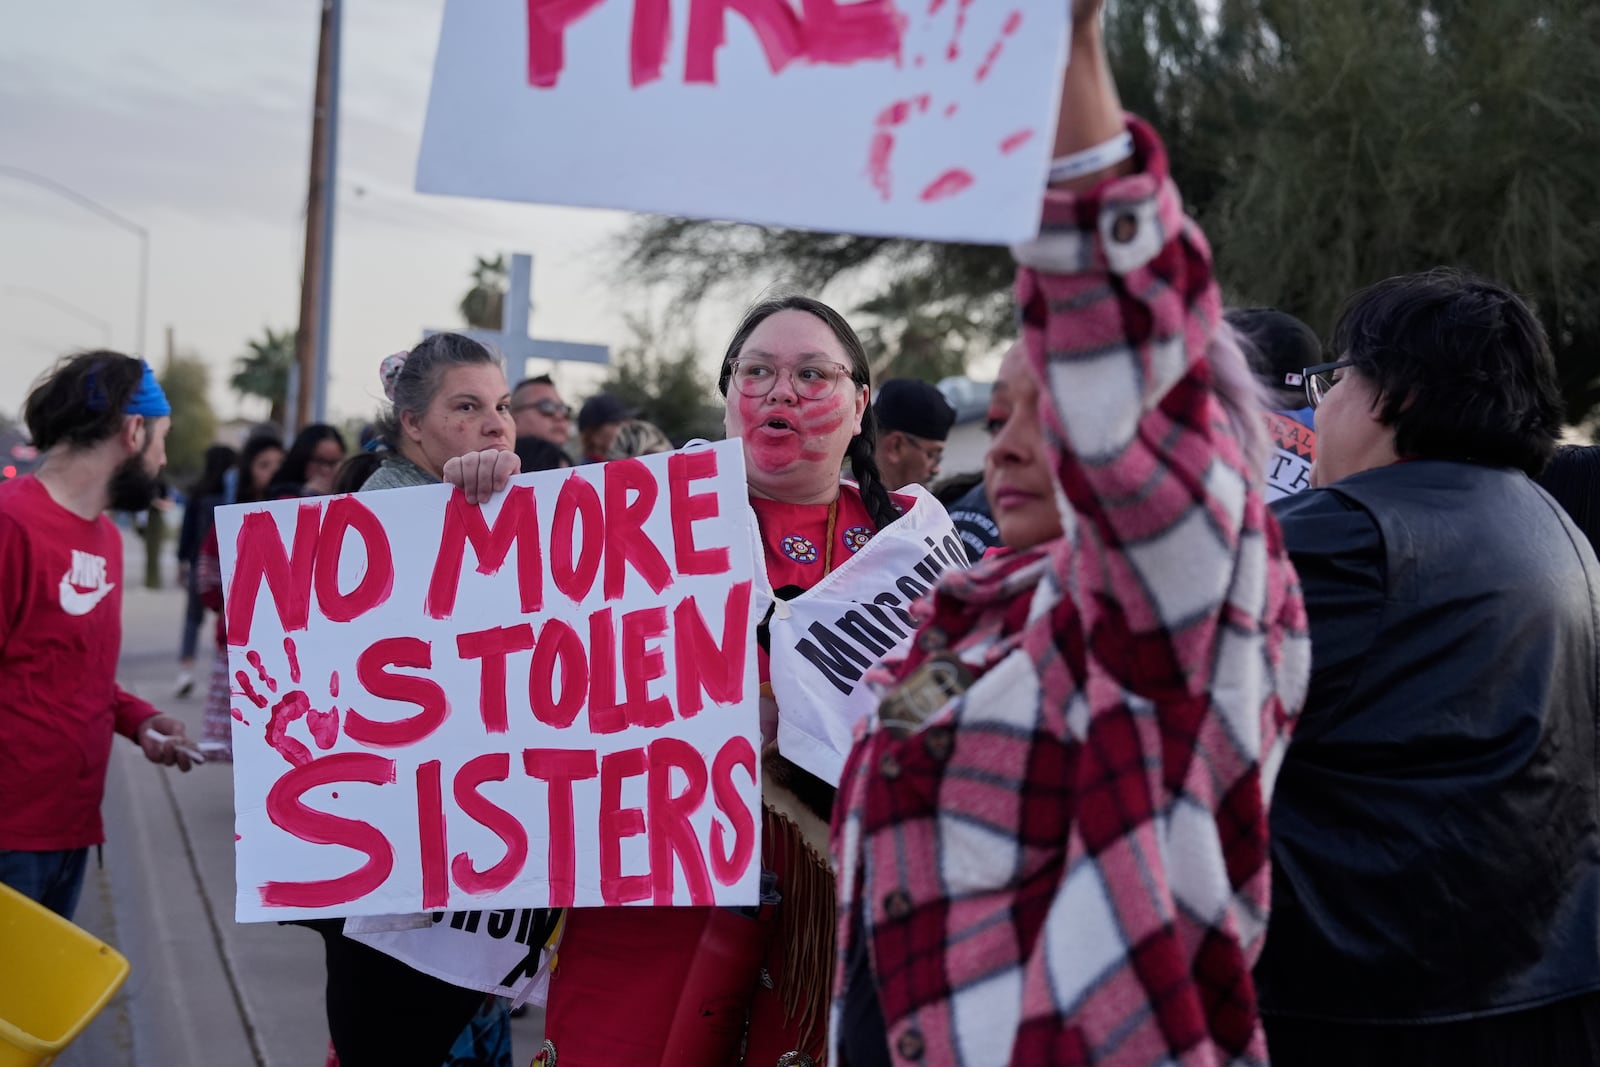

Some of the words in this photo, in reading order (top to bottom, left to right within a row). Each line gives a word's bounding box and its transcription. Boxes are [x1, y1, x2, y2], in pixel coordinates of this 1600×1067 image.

[226, 494, 394, 646] NO
[424, 450, 731, 619] MORE
[343, 579, 753, 748] STOLEN
[258, 736, 758, 909] SISTERS
